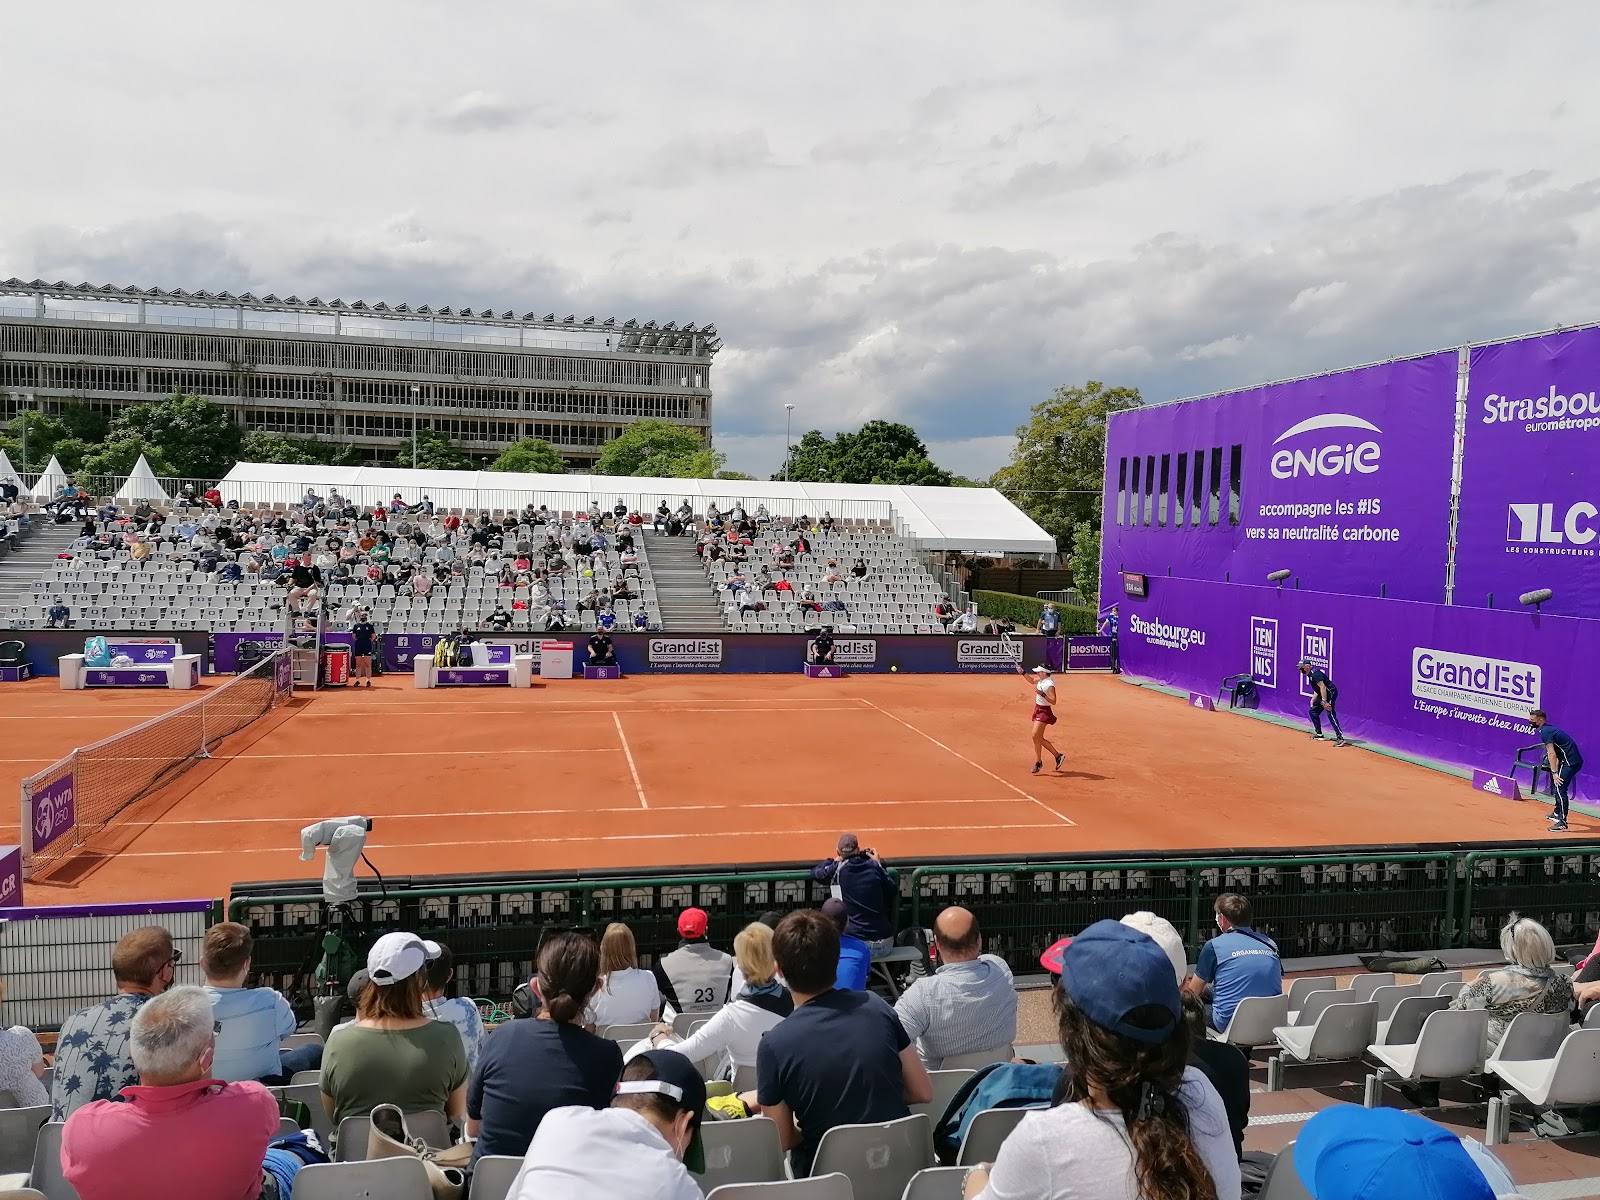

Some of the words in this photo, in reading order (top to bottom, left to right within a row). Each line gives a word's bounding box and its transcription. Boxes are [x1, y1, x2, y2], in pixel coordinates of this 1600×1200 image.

[1259, 503, 1332, 518] accompagne
[1335, 499, 1354, 515] les
[1245, 526, 1265, 539] vers
[1267, 528, 1280, 540] sa
[1282, 524, 1339, 541] neutralité
[1342, 525, 1400, 541] carbone
[1523, 547, 1595, 556] CONSTRUCTEURS
[1255, 627, 1272, 647] TEN
[1306, 635, 1327, 657] TEN
[1070, 645, 1110, 654] BIOSYNEX
[1255, 656, 1272, 677] NIS
[1416, 685, 1438, 696] ALSACE
[1504, 701, 1535, 713] LORRAINE
[1413, 699, 1448, 720] L'Europe
[1449, 706, 1487, 725] s'invente
[1488, 714, 1512, 731] chez
[1513, 722, 1537, 736] nous
[55, 807, 69, 827] 250
[694, 987, 715, 1004] 23
